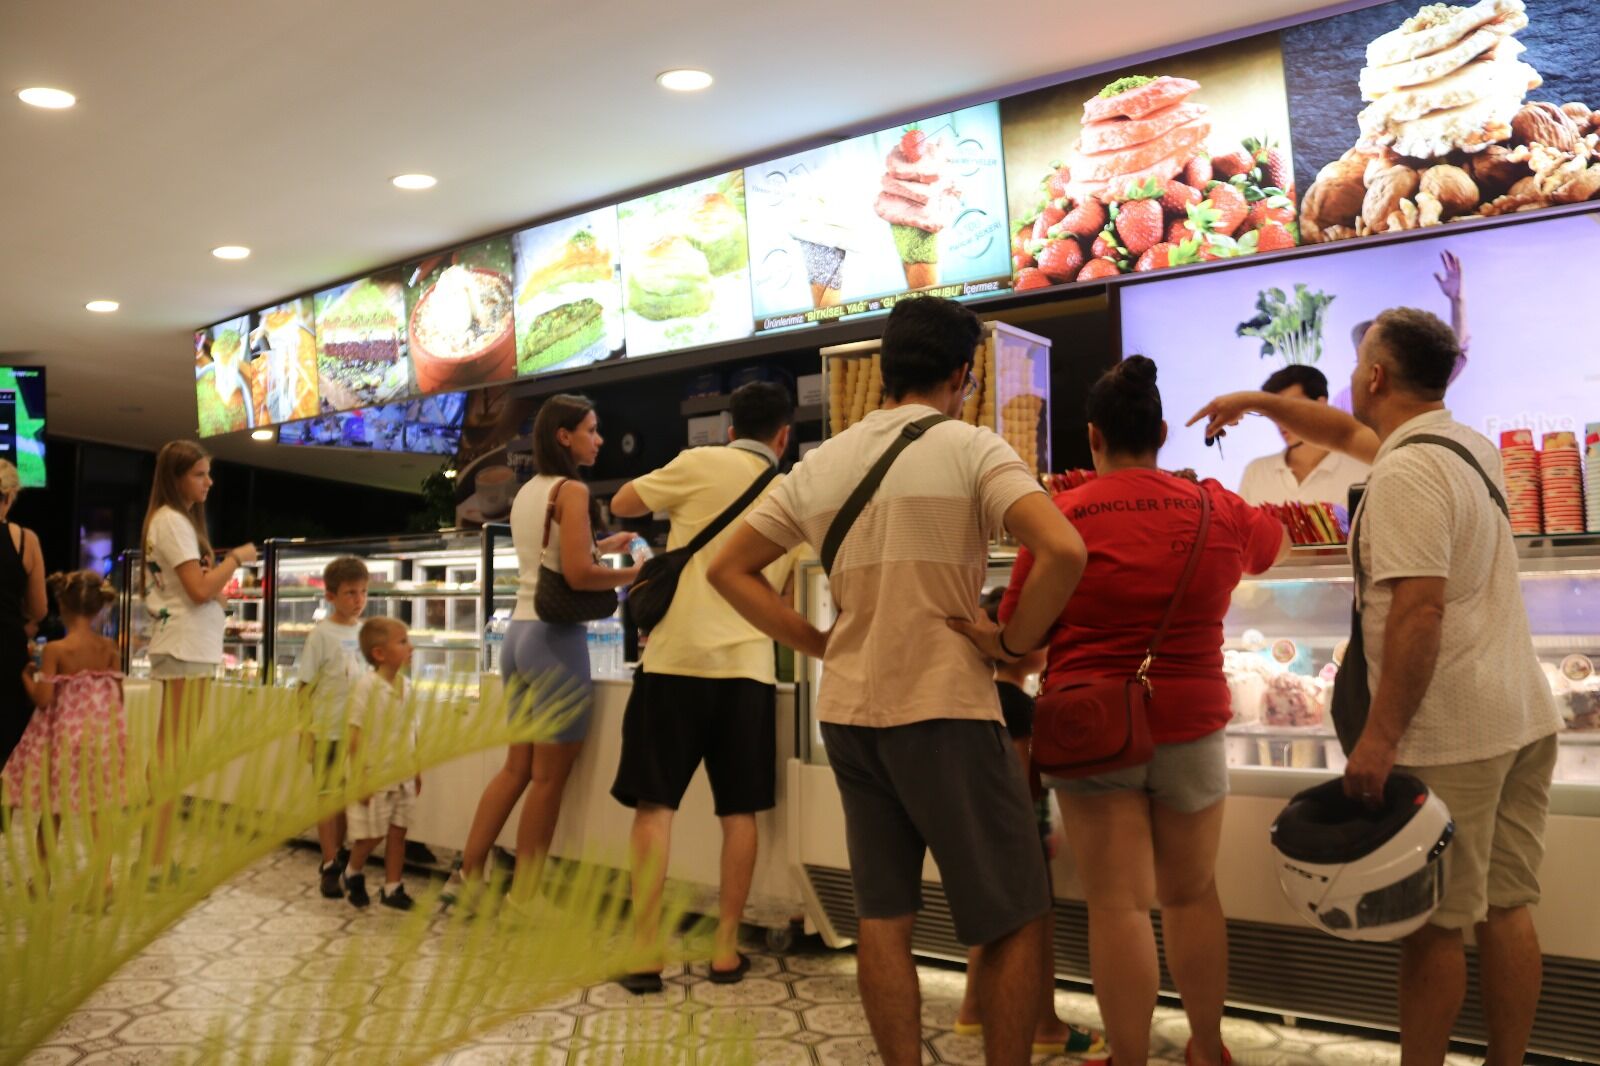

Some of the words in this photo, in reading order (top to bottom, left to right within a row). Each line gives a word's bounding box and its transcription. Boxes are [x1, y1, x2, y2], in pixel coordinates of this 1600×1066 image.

[763, 314, 804, 330] Ürünlerimiz
[868, 301, 880, 310] ve
[963, 281, 998, 296] İçermez
[1073, 499, 1159, 520] MONCLER
